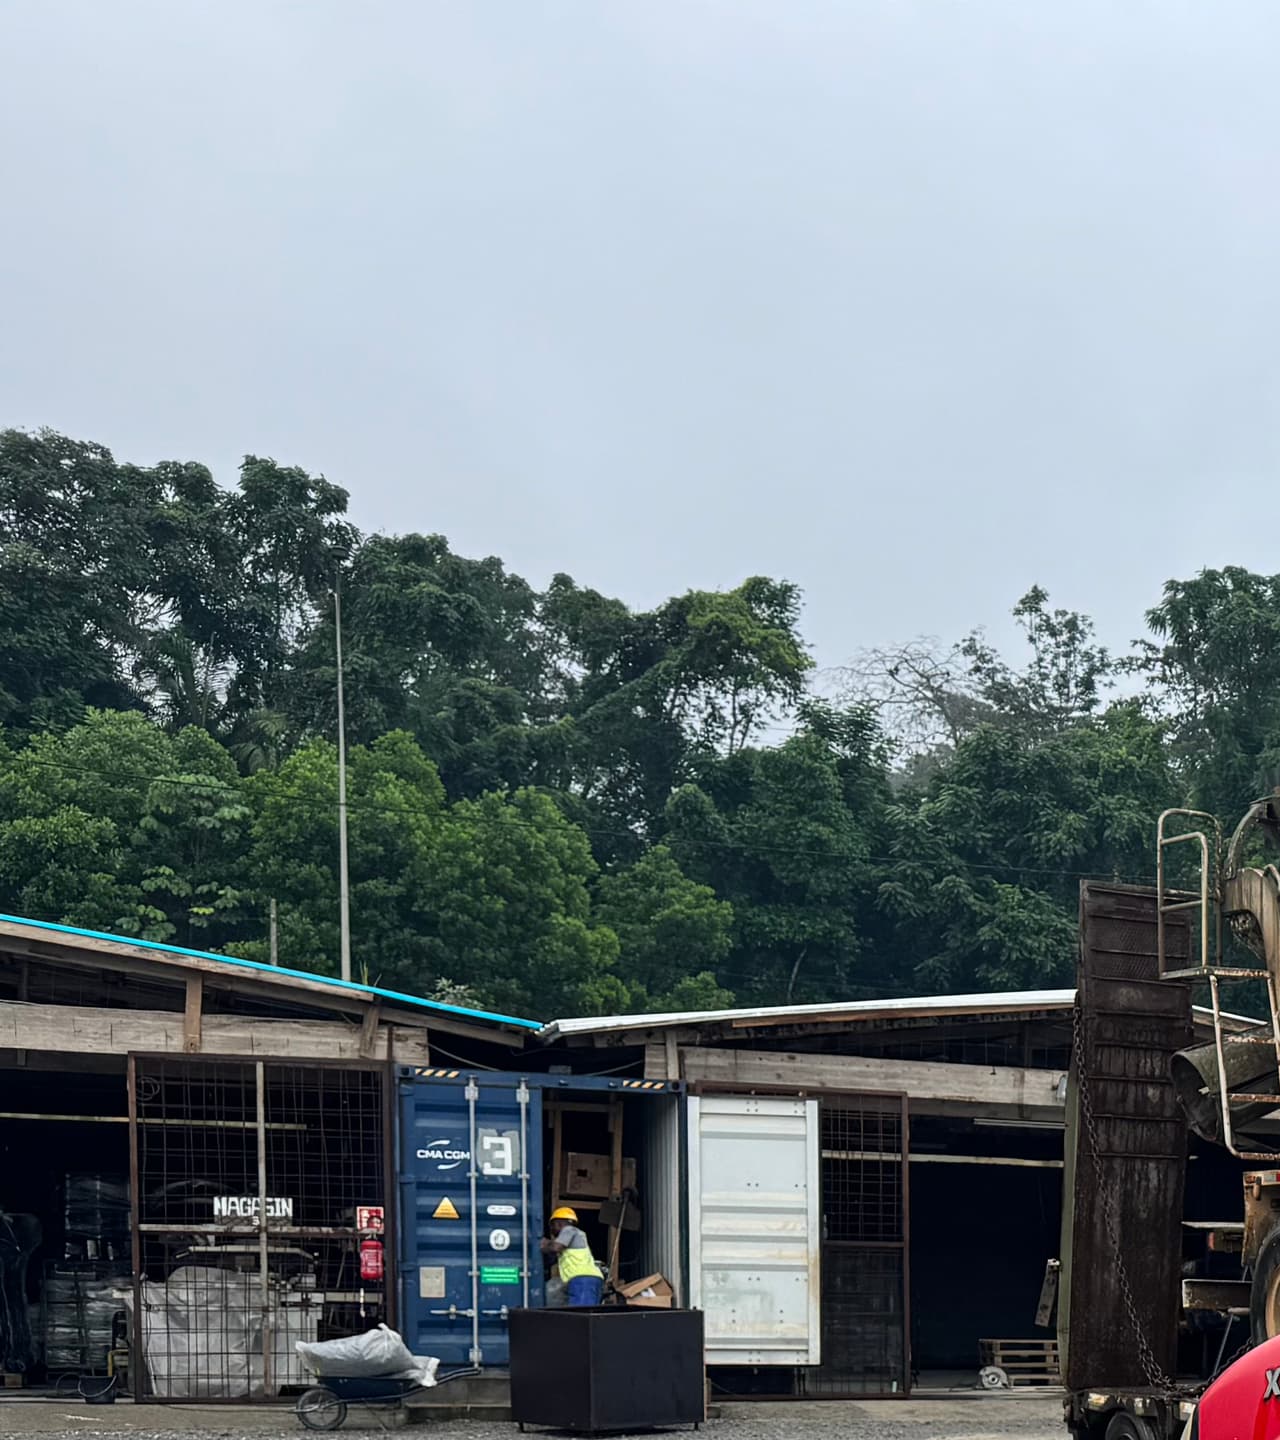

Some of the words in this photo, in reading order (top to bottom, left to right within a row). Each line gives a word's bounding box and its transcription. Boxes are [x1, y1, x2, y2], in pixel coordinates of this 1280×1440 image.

[416, 1149, 443, 1159] CMA
[444, 1150, 471, 1160] CGM
[483, 1135, 512, 1176] 3
[213, 1196, 293, 1217] MAGASIN
